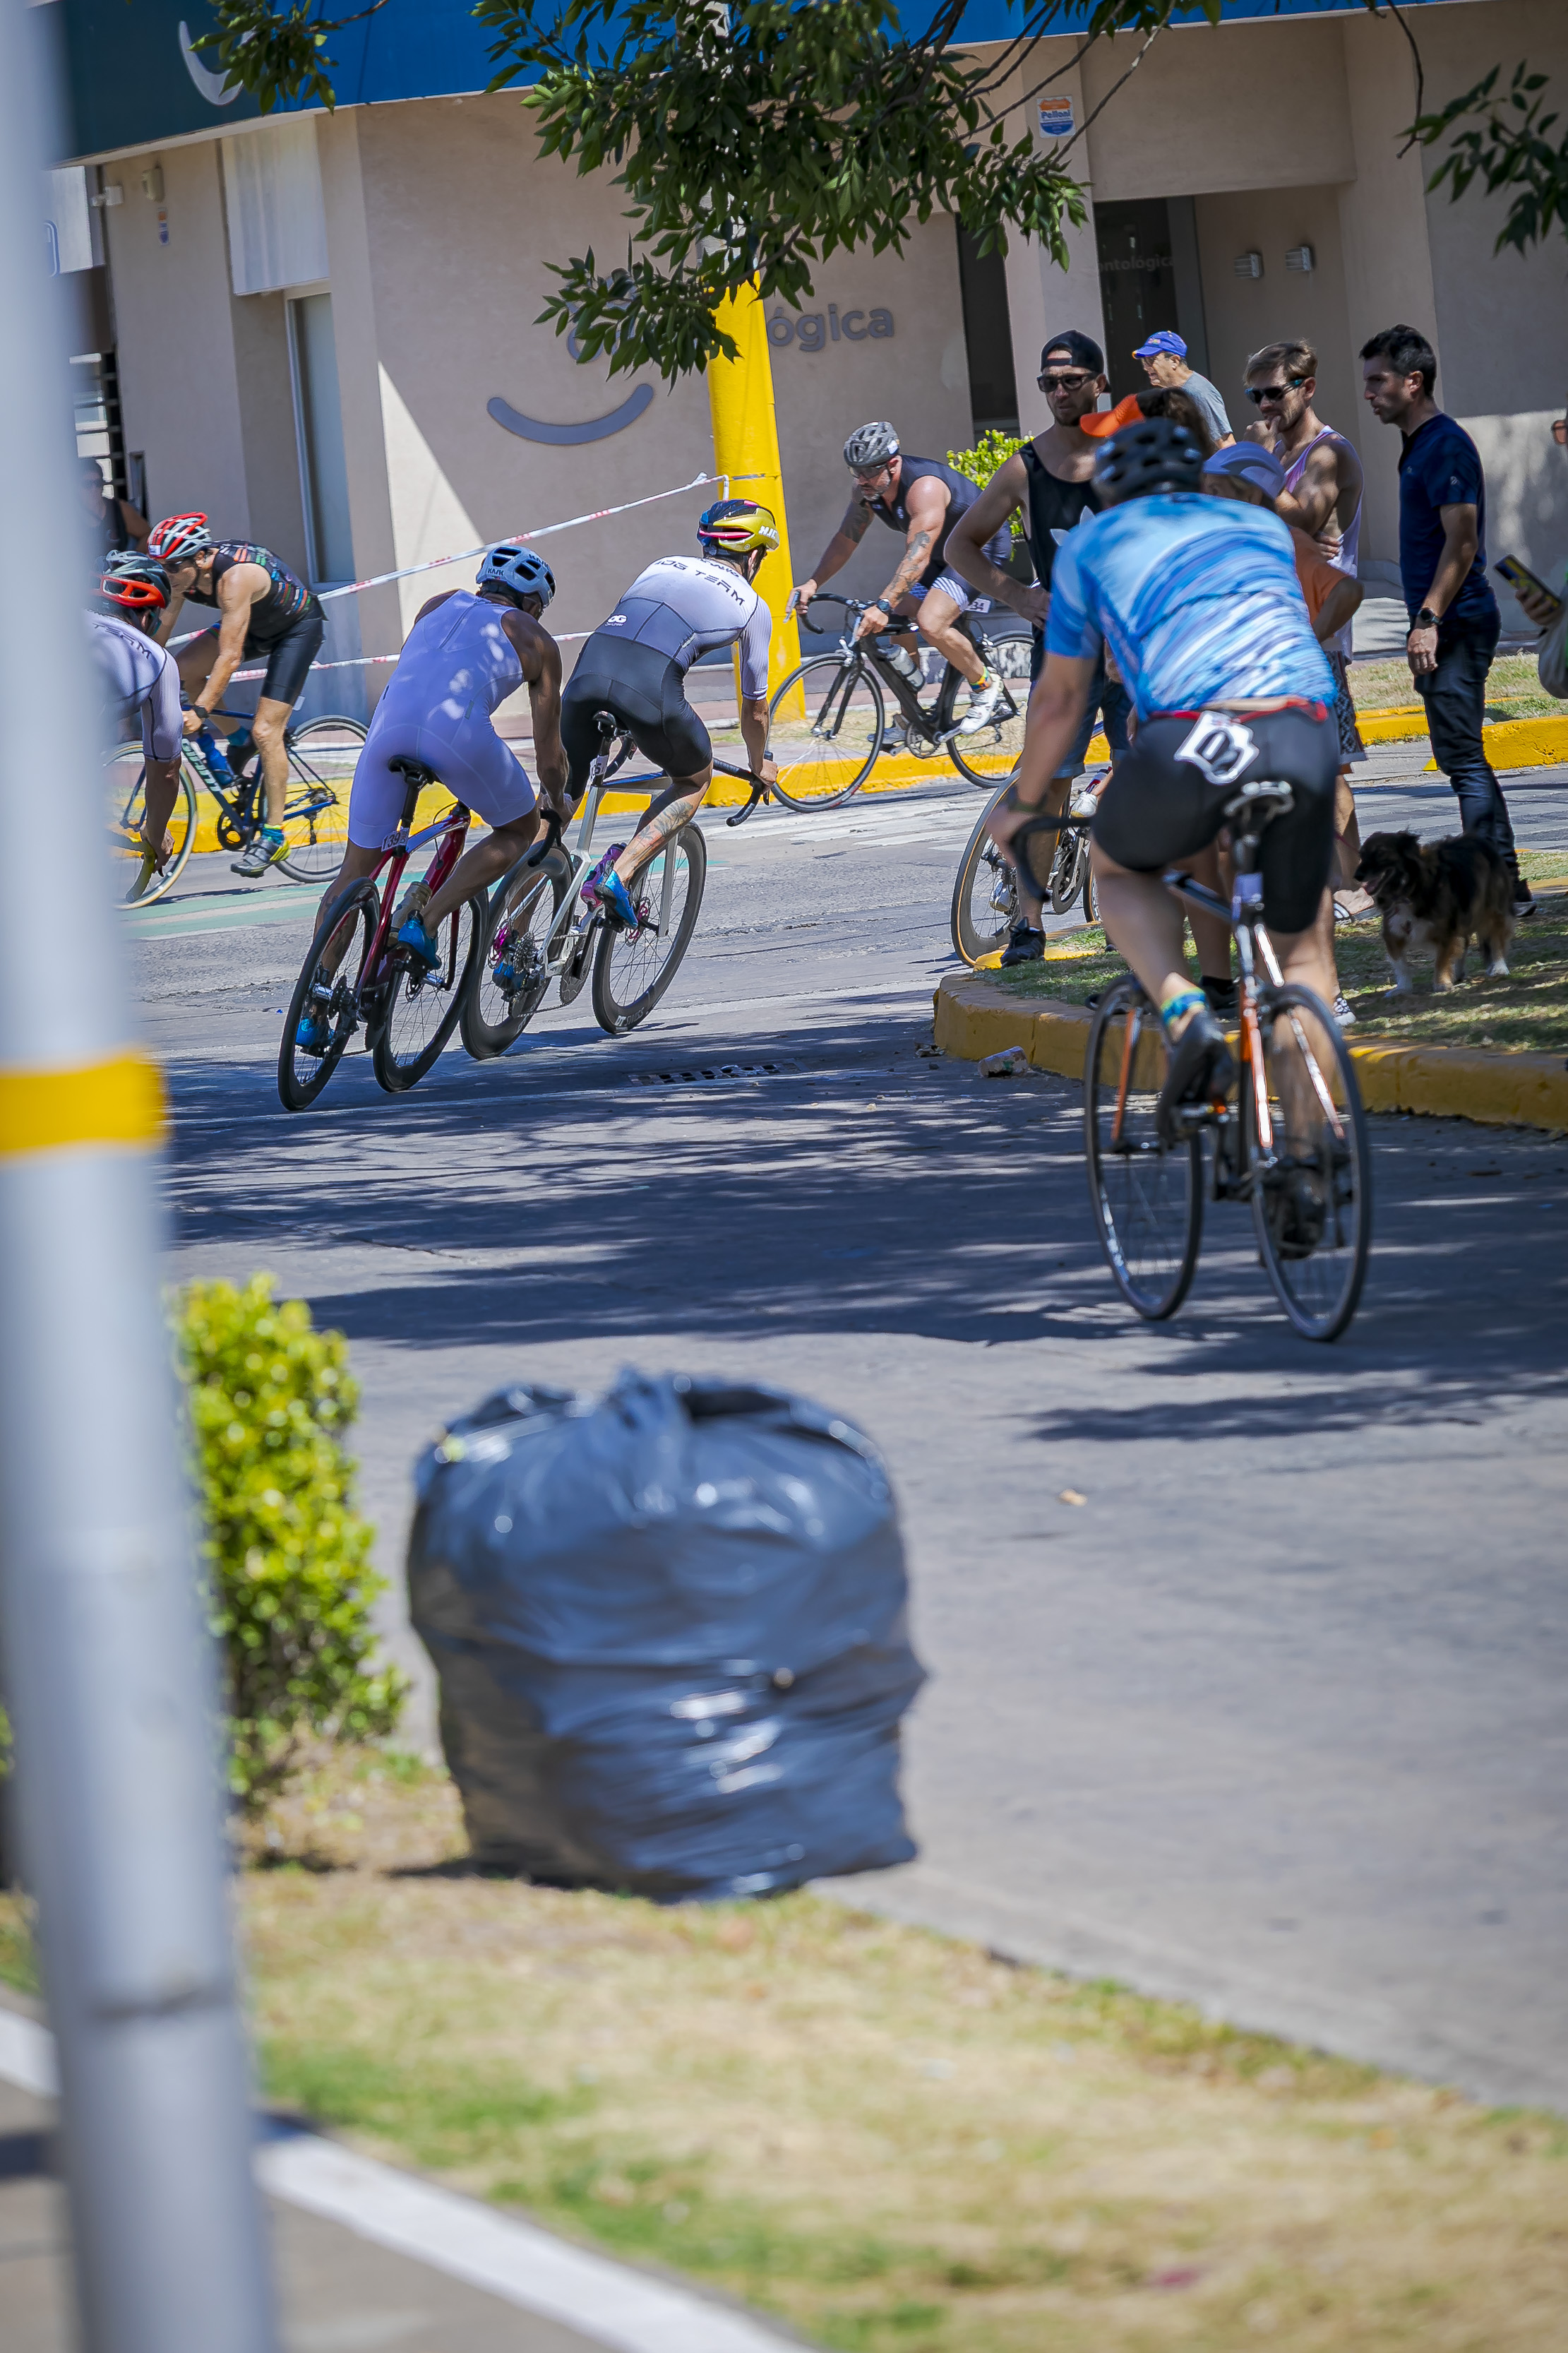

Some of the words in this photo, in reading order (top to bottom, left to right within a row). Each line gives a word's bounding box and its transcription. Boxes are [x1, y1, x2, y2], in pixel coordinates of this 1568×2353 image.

[488, 568, 504, 576] KASK
[695, 570, 746, 606] TEAM
[92, 623, 152, 660] TEAM
